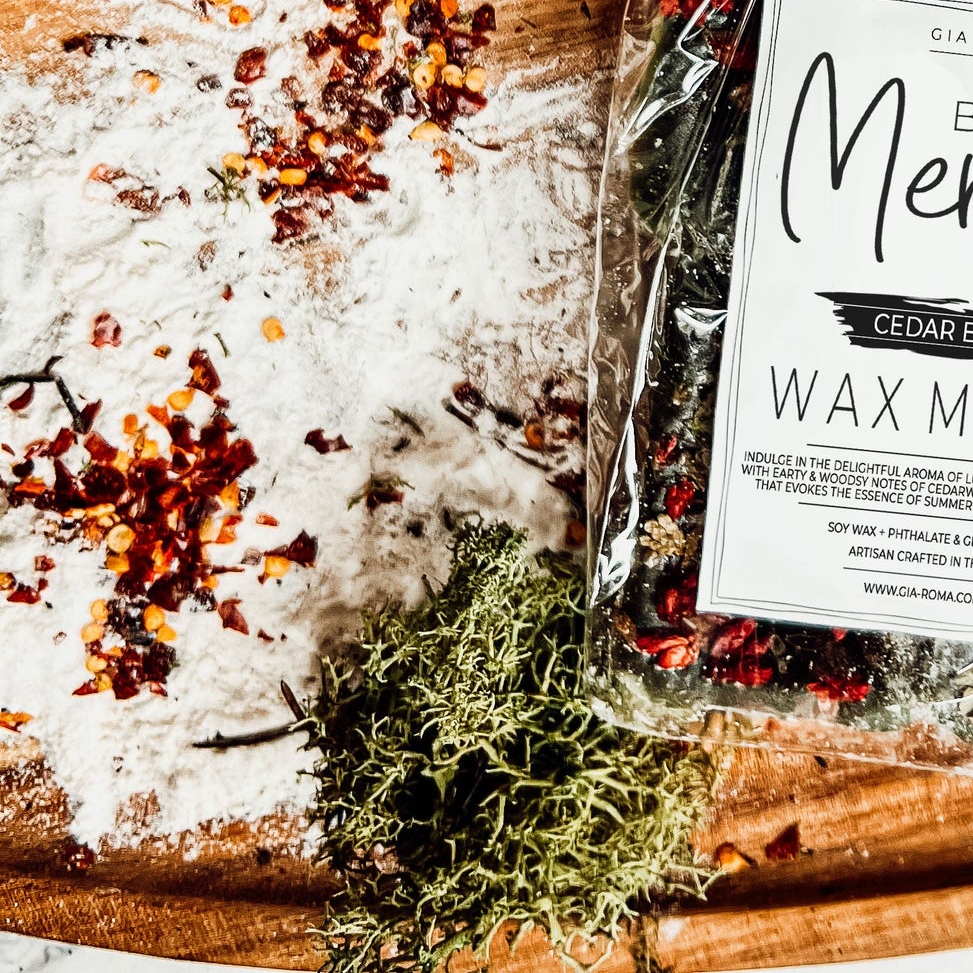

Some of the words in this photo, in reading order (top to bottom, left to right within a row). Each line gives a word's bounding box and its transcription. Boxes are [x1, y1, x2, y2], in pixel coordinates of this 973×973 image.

[931, 28, 967, 45] GIA
[874, 313, 955, 341] CEDAR
[771, 366, 903, 431] WAX
[741, 464, 770, 477] WITH
[773, 468, 808, 481] EARTY
[809, 470, 817, 482] &
[819, 472, 868, 487] WOODSY
[871, 477, 907, 491] NOTES
[910, 481, 926, 493] OF
[744, 451, 793, 467] INDULGE
[795, 456, 806, 467] IN
[810, 457, 831, 469] THE
[834, 460, 901, 477] DELIGHTFUL
[904, 467, 944, 481] AROMA
[947, 471, 963, 483] OF
[755, 478, 783, 491] THAT
[785, 481, 828, 497] EVOKES
[831, 486, 852, 499] THE
[855, 489, 904, 504] ESSENCE
[906, 494, 922, 505] OF
[924, 495, 973, 511] SUMMER
[828, 521, 850, 533] SOY
[852, 525, 877, 537] WAX
[888, 528, 951, 545] PHTHALATE
[953, 534, 961, 545] &
[848, 546, 895, 561] ARTISAN
[897, 551, 947, 566] CRAFTED
[950, 556, 961, 568] IN
